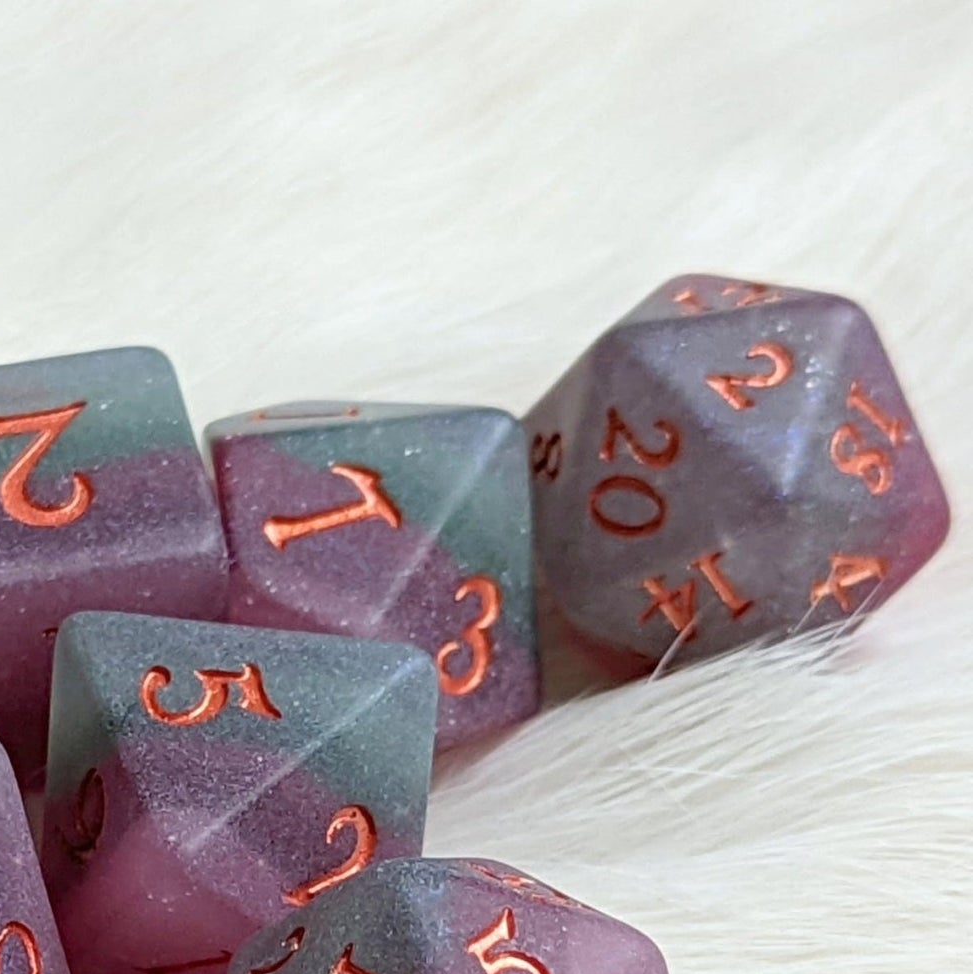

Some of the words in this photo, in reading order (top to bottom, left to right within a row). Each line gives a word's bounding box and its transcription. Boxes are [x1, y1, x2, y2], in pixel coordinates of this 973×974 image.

[705, 340, 794, 412] 2
[263, 462, 403, 552] 1
[589, 406, 683, 539] 20
[437, 572, 503, 697] 3
[139, 661, 284, 728] 5
